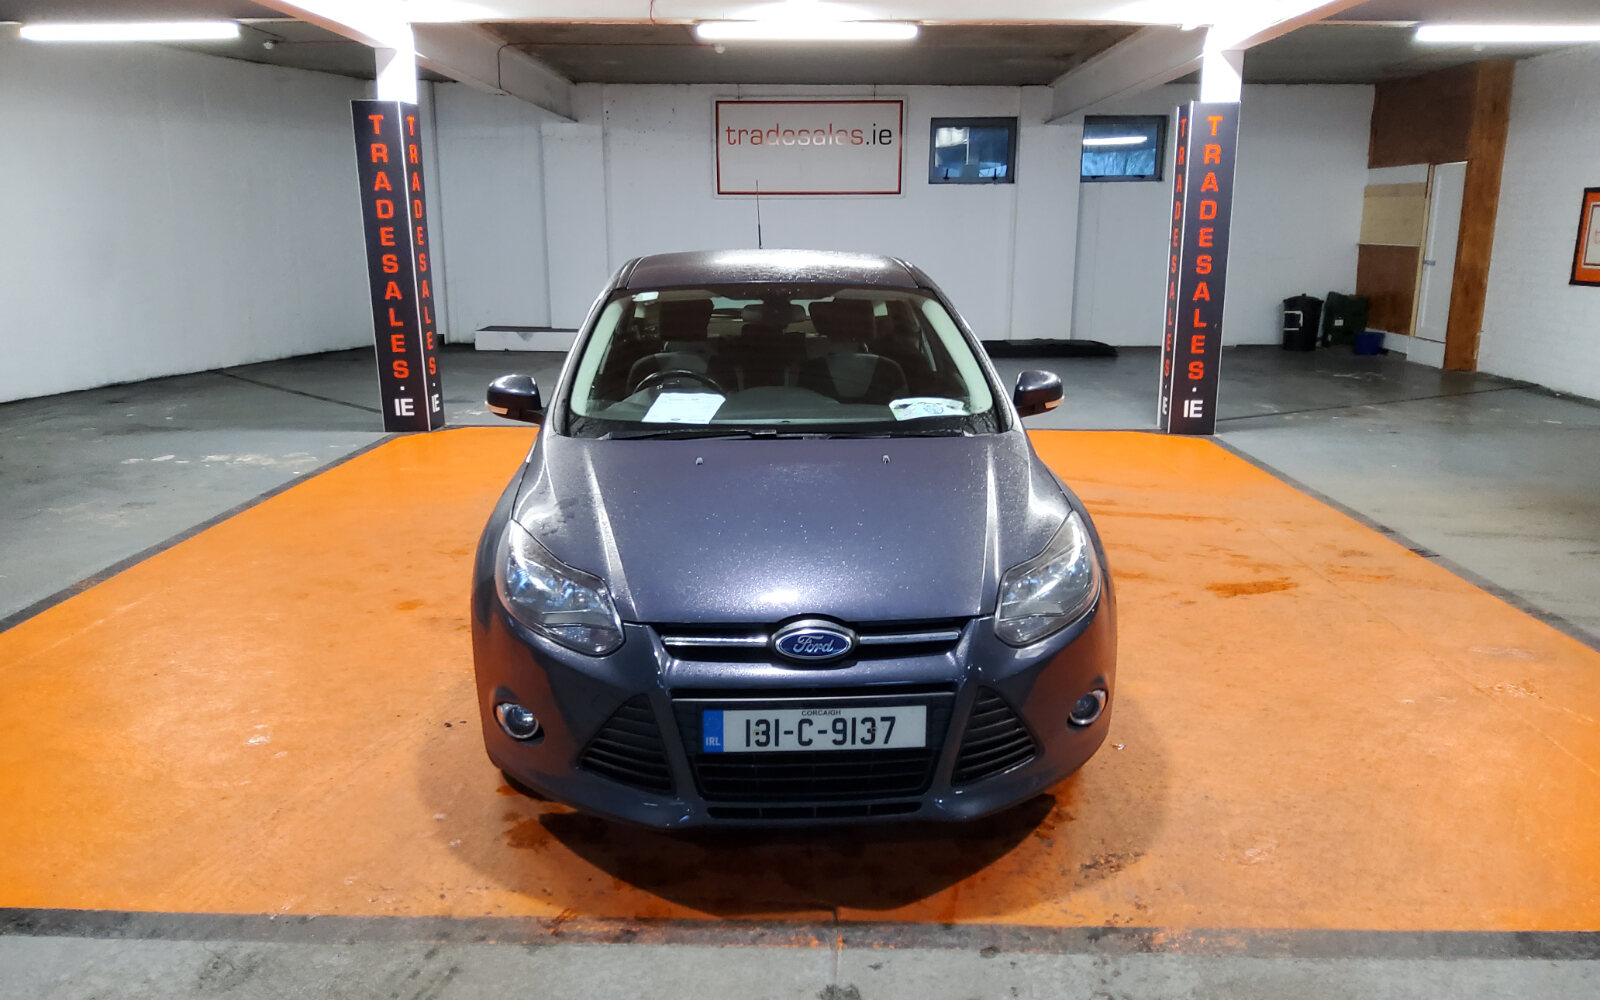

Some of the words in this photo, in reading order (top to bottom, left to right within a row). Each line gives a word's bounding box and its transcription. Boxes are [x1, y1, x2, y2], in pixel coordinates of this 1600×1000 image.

[725, 123, 892, 145] tradesales.ie
[369, 114, 414, 416] TRADESALES.IE
[1183, 115, 1223, 418] TRADESALES.IE
[793, 634, 834, 653] Ford
[705, 736, 721, 746] IRL
[745, 716, 896, 748] 131-C-9137
